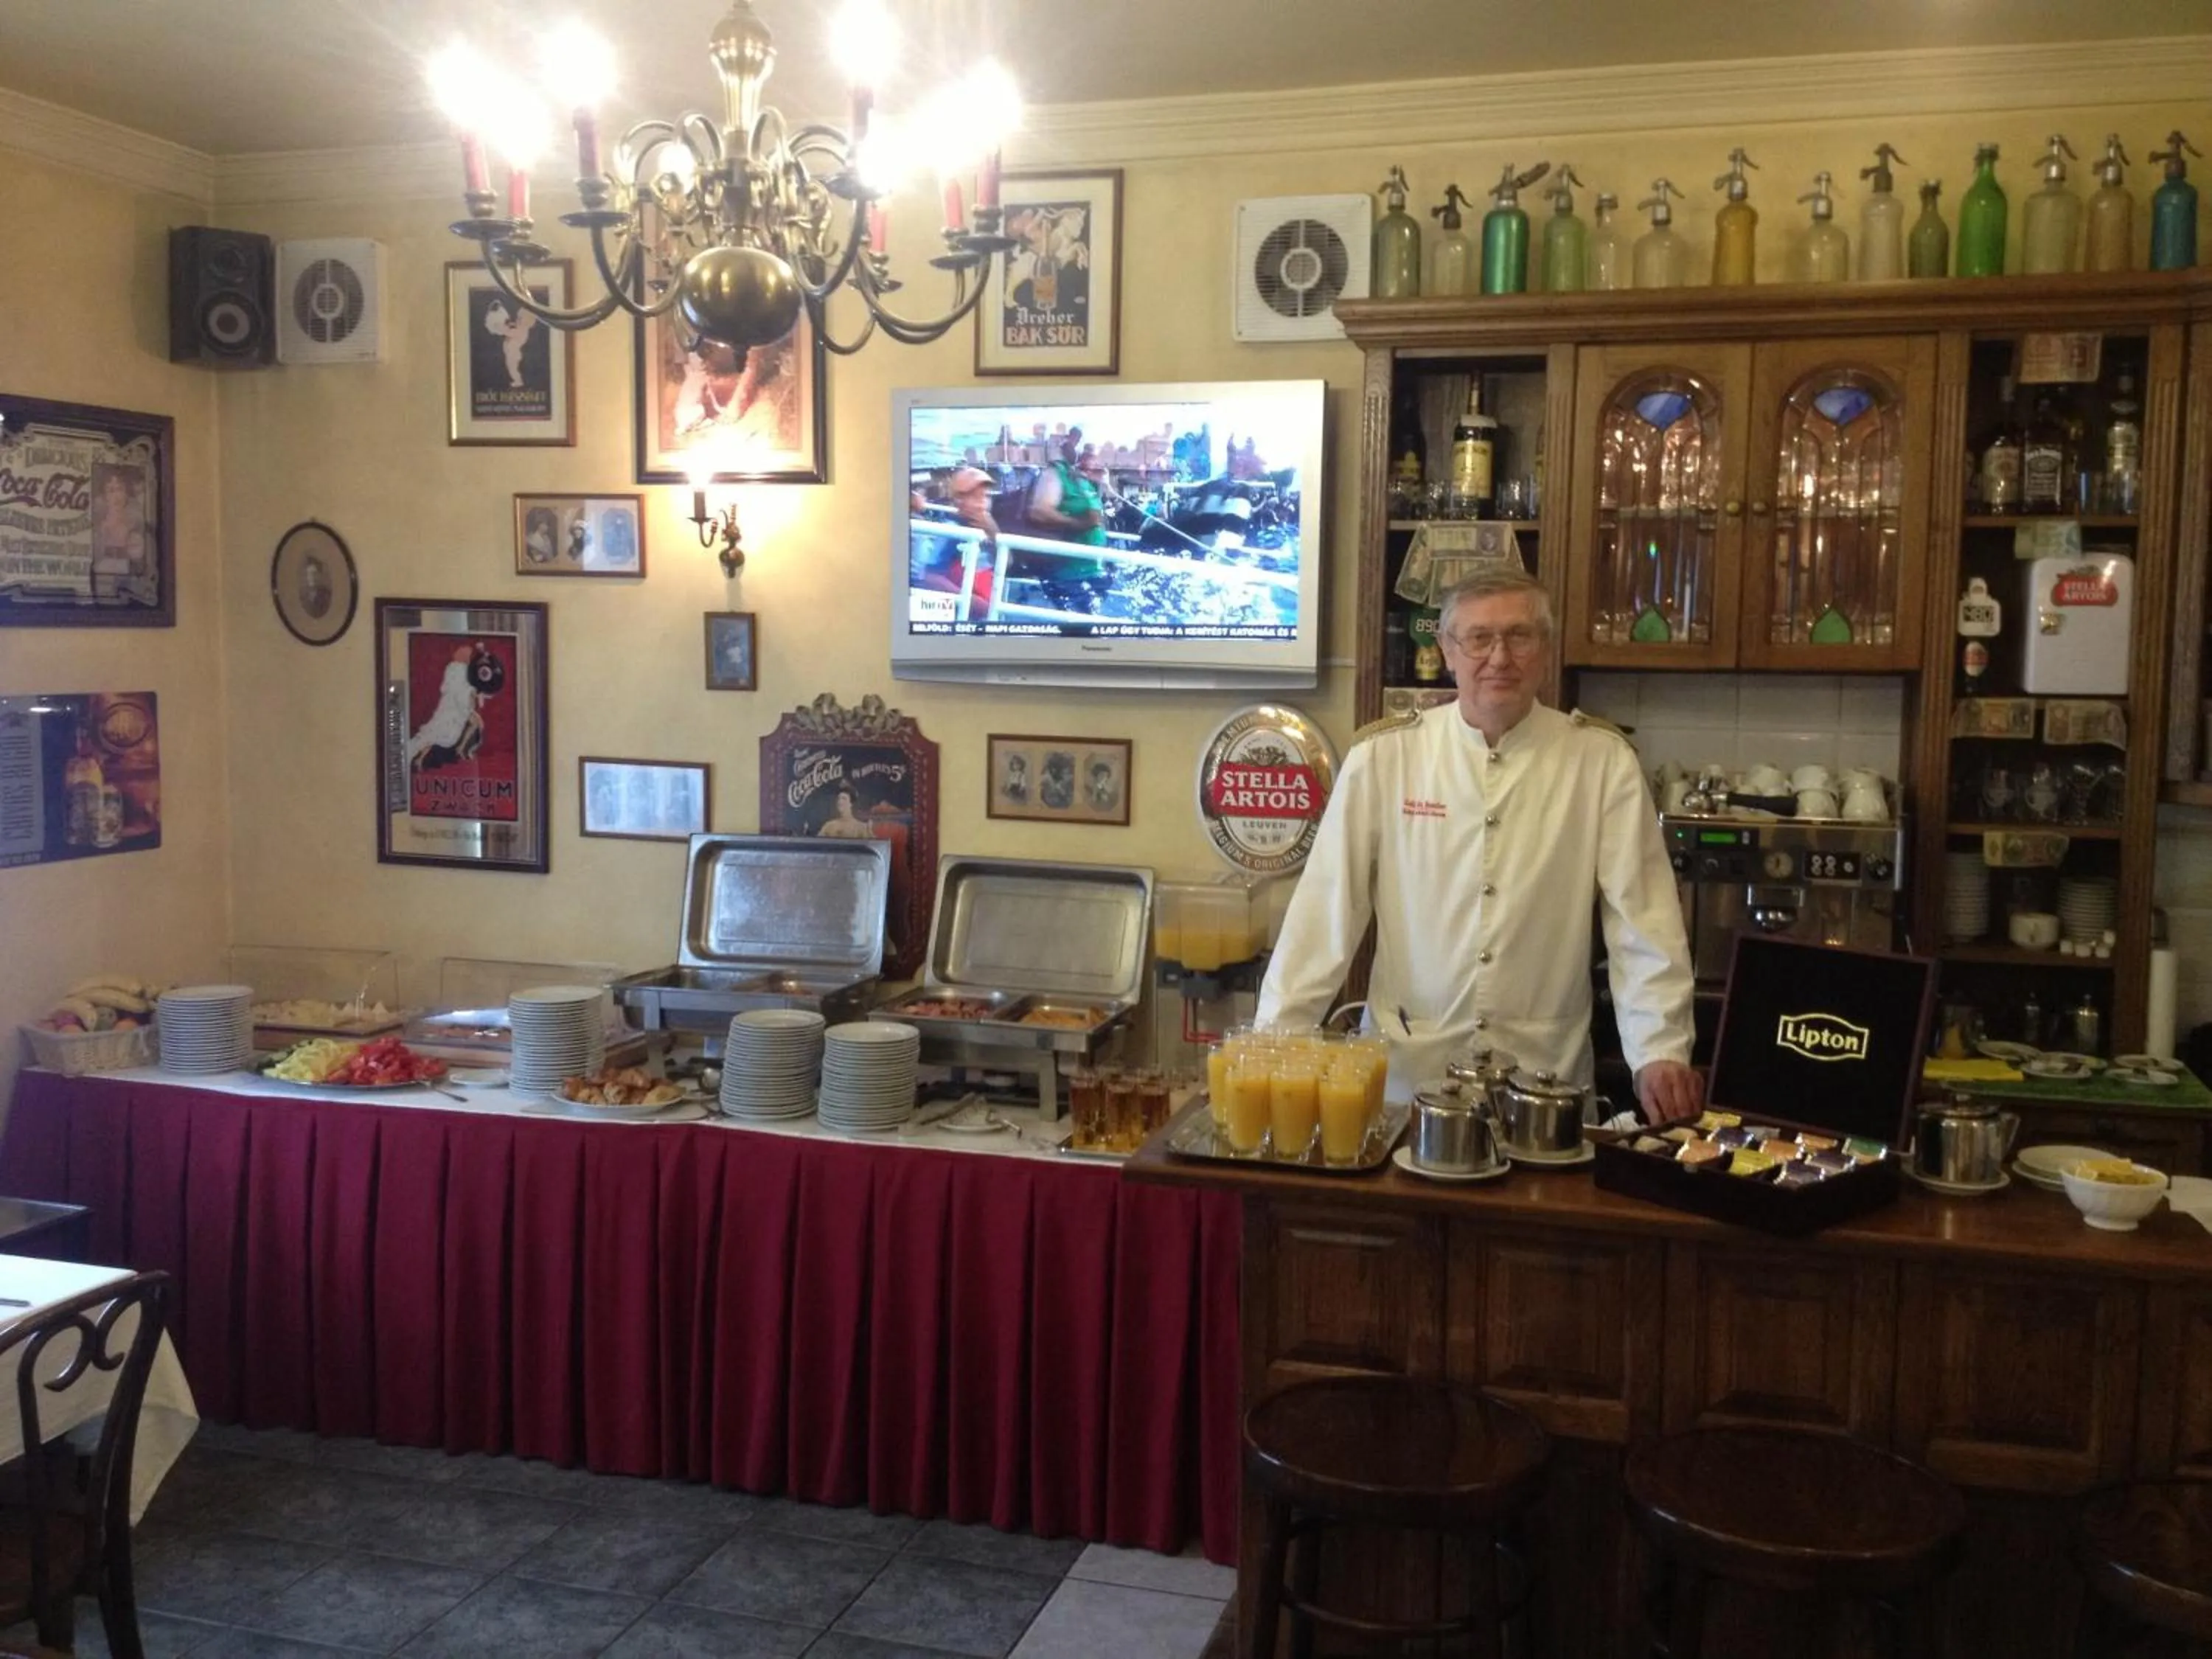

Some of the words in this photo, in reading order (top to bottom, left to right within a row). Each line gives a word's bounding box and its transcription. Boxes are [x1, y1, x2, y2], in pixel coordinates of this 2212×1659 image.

[415, 778, 512, 799] UNICUM
[1221, 771, 1310, 791] STELLA
[1221, 790, 1311, 810] ARTOIS
[1242, 821, 1287, 830] LEUVEN
[1786, 1021, 1859, 1051] Lipton
